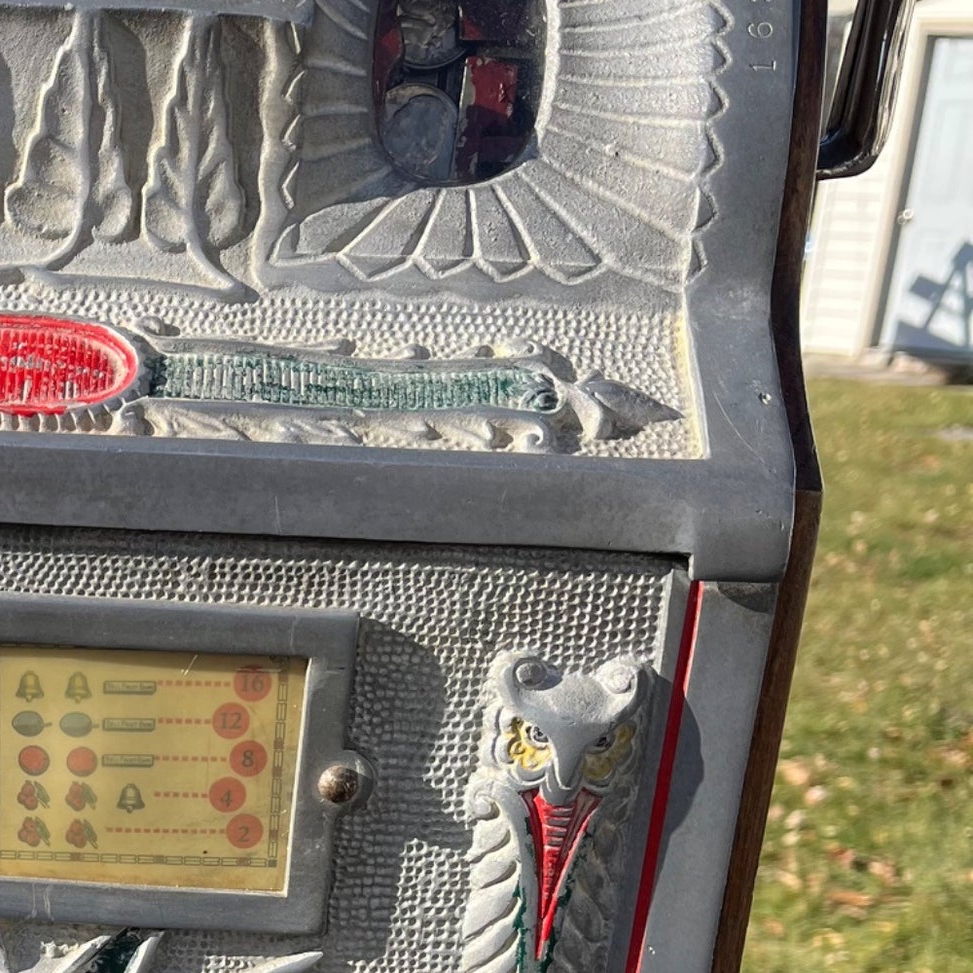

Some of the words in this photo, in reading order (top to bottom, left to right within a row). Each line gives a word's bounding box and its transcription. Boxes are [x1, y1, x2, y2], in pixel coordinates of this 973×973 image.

[747, 0, 777, 72] 16
[240, 676, 264, 694] 16
[220, 713, 242, 730] 12
[242, 750, 254, 767] 8
[220, 789, 232, 807] 4
[238, 826, 250, 843] 2
